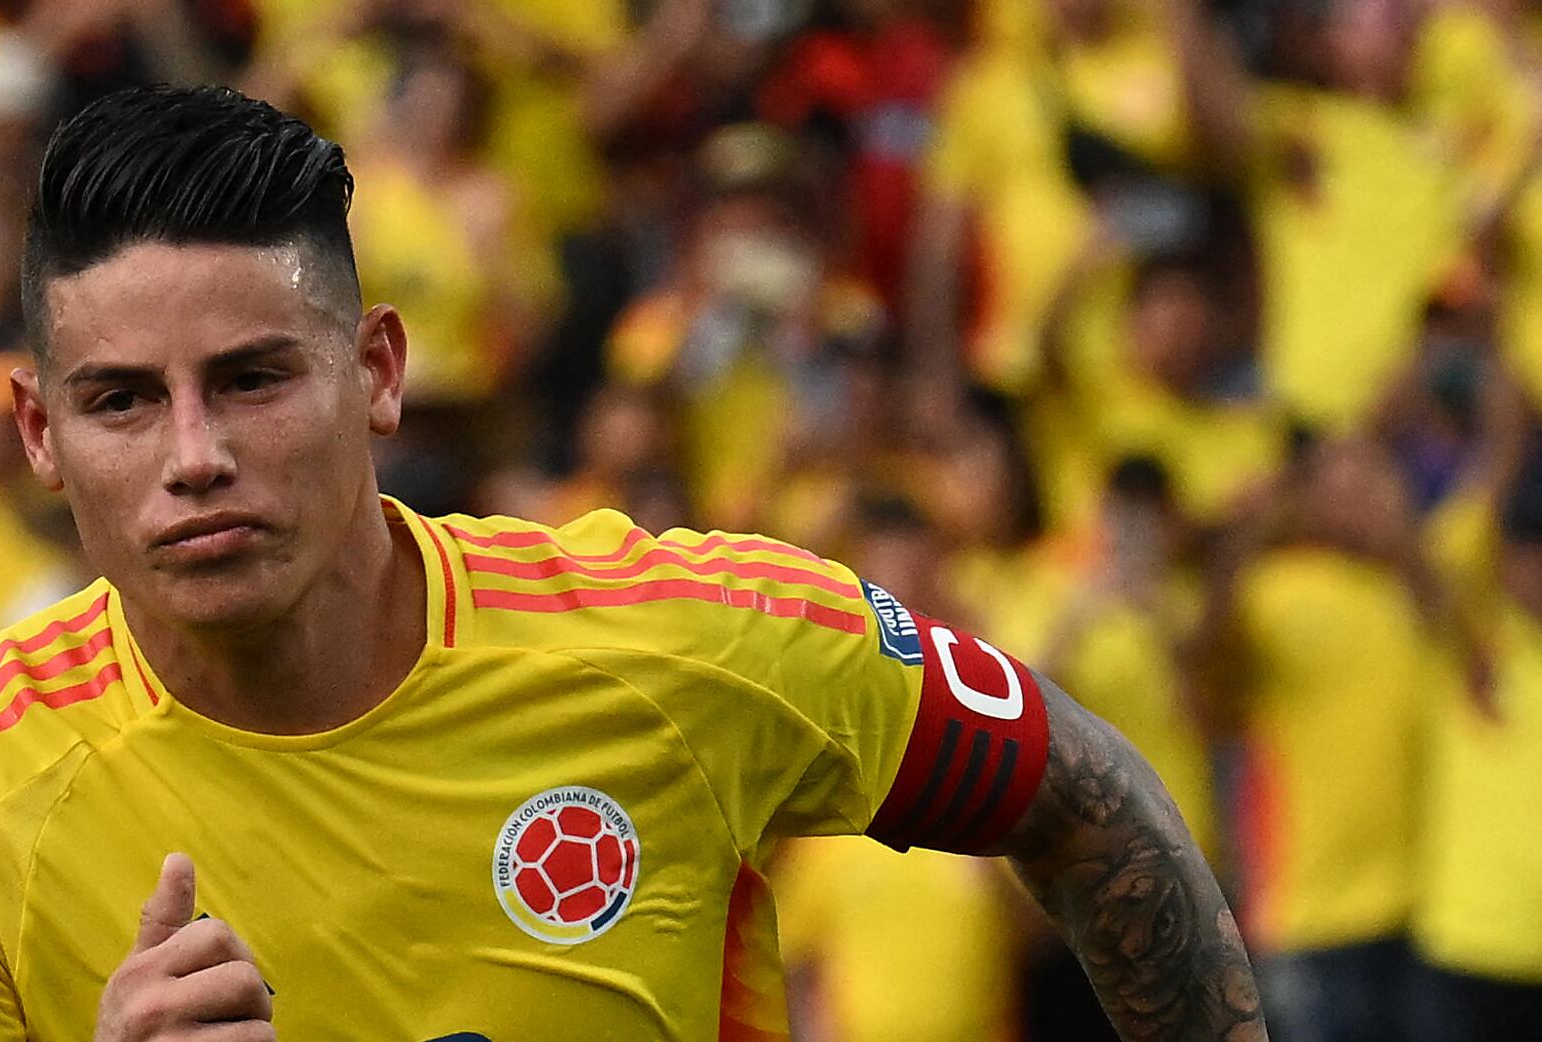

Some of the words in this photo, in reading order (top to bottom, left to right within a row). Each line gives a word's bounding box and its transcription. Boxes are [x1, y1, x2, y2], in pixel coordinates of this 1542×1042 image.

[930, 626, 1024, 720] C
[520, 791, 587, 822] COLOMBIANA
[588, 794, 602, 807] DE
